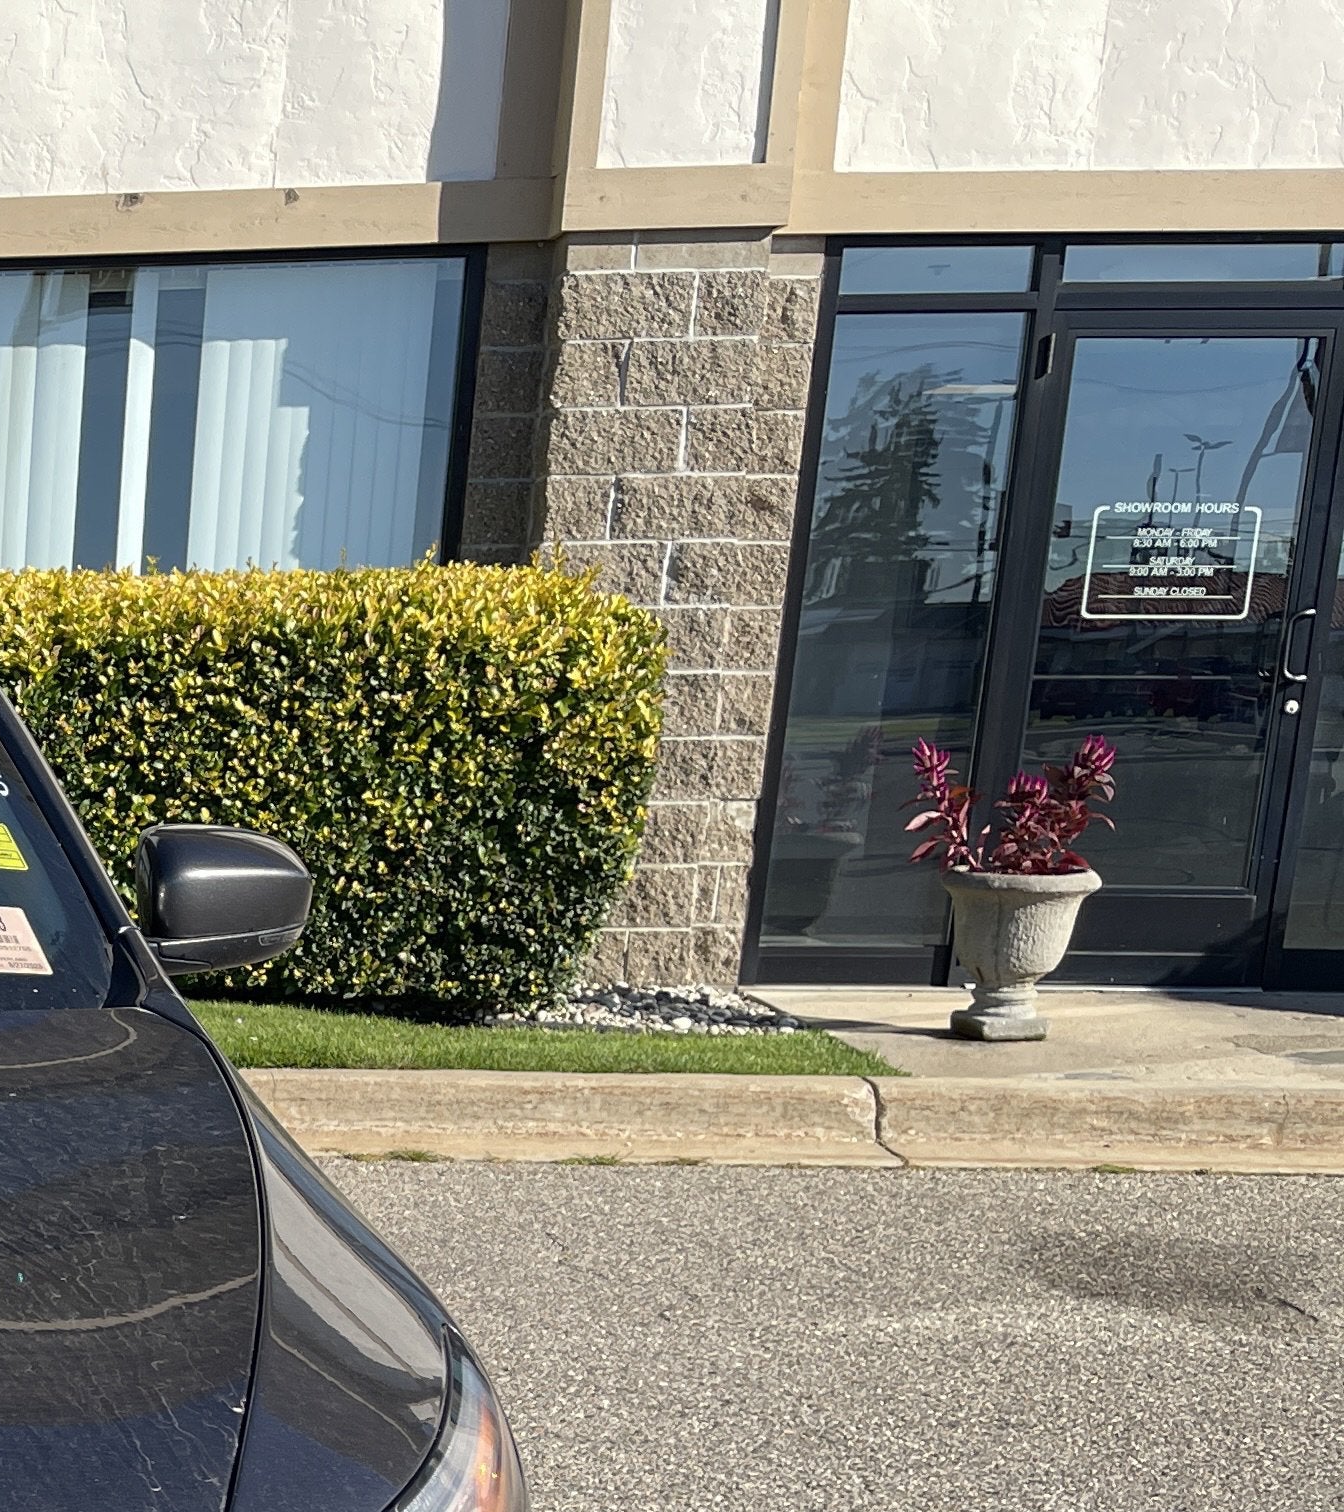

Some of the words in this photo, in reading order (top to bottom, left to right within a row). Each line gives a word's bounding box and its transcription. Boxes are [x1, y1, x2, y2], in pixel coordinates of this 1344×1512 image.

[1114, 502, 1192, 513] SHOWROOM
[1195, 502, 1240, 513] HOURS
[1137, 528, 1174, 537] MONDAY
[1181, 528, 1213, 537] FRIDAY
[1133, 539, 1153, 548] 8:30
[1154, 539, 1172, 548] AM
[1201, 539, 1218, 548] PM
[1149, 557, 1196, 566] SATURDAY
[1129, 567, 1149, 576] 9:00
[1150, 567, 1168, 576] AM
[1198, 567, 1215, 576] PM
[1134, 586, 1169, 596] SUNDAY
[1170, 587, 1206, 596] CLOSED
